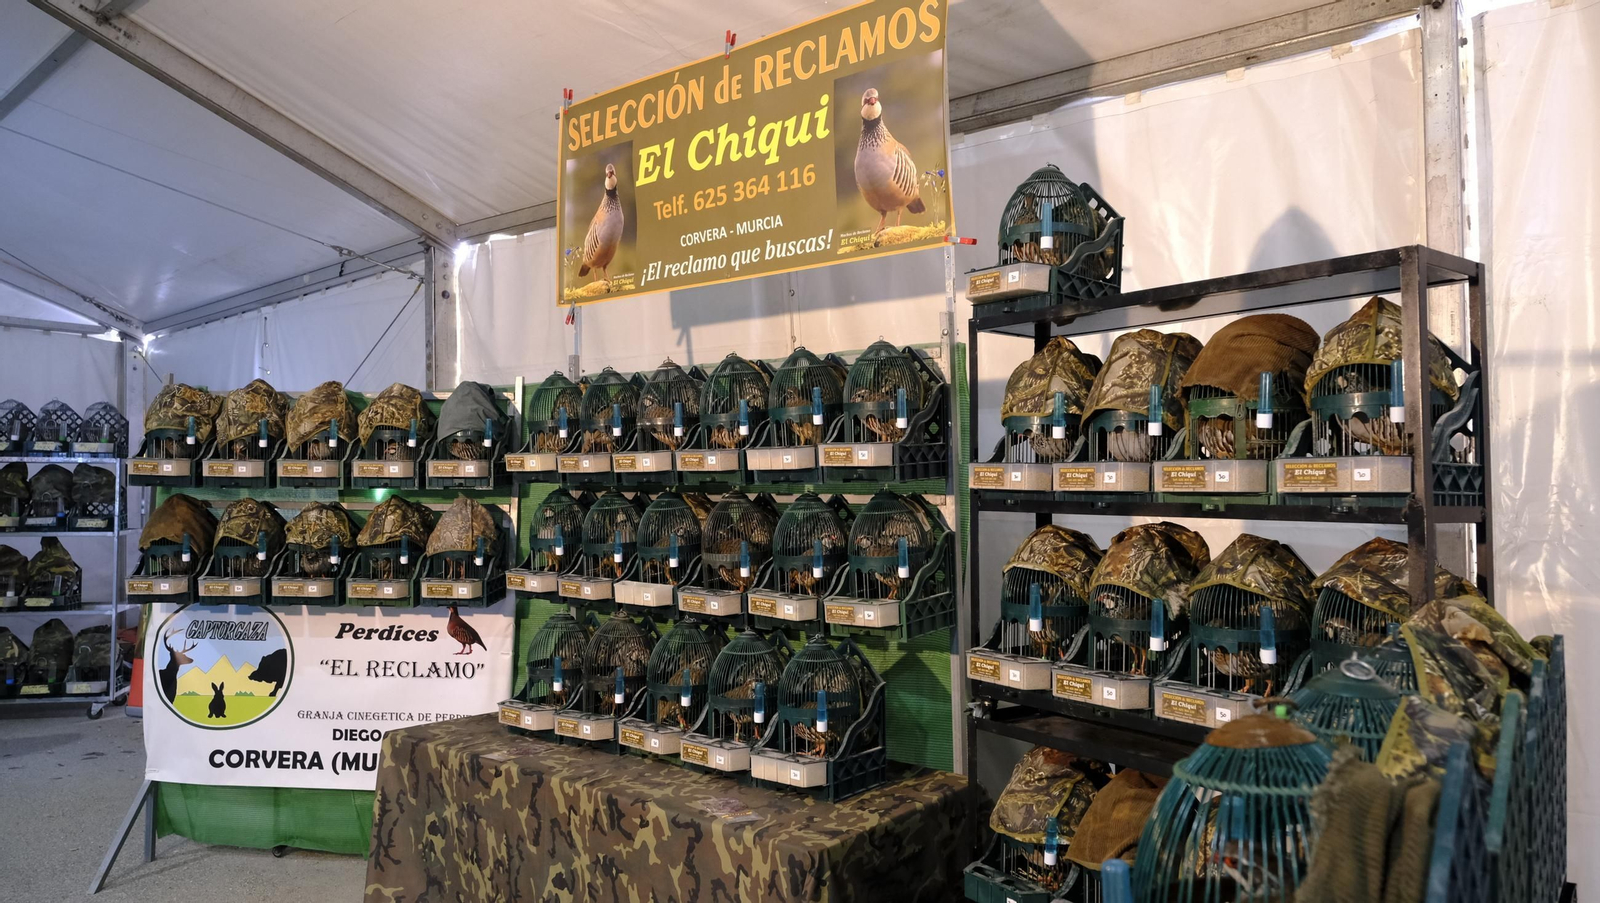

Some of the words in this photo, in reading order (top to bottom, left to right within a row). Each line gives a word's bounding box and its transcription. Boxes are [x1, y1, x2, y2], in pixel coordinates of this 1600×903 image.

[568, 72, 705, 151] SELECCIÓN
[754, 0, 941, 94] RECLAMOS
[635, 138, 675, 187] El
[687, 94, 830, 171] Chiqui
[653, 193, 689, 221] Telf.
[693, 185, 728, 212] 625
[733, 174, 770, 202] 364
[777, 163, 816, 193] 116
[680, 226, 728, 247] CORVERA
[736, 214, 783, 236] MURCIA
[640, 261, 661, 287] ¡El
[663, 253, 727, 279] reclamo
[731, 246, 761, 272] que
[764, 228, 834, 261] buscas!
[335, 622, 440, 642] Perdices
[297, 710, 344, 721] GRANJA
[347, 711, 414, 722] CINEGETICA
[418, 712, 432, 722] DE
[1178, 701, 1197, 710] Chiqui
[332, 728, 382, 742] DIEGO
[208, 748, 324, 770] CORVERA
[331, 751, 378, 776] (MU
